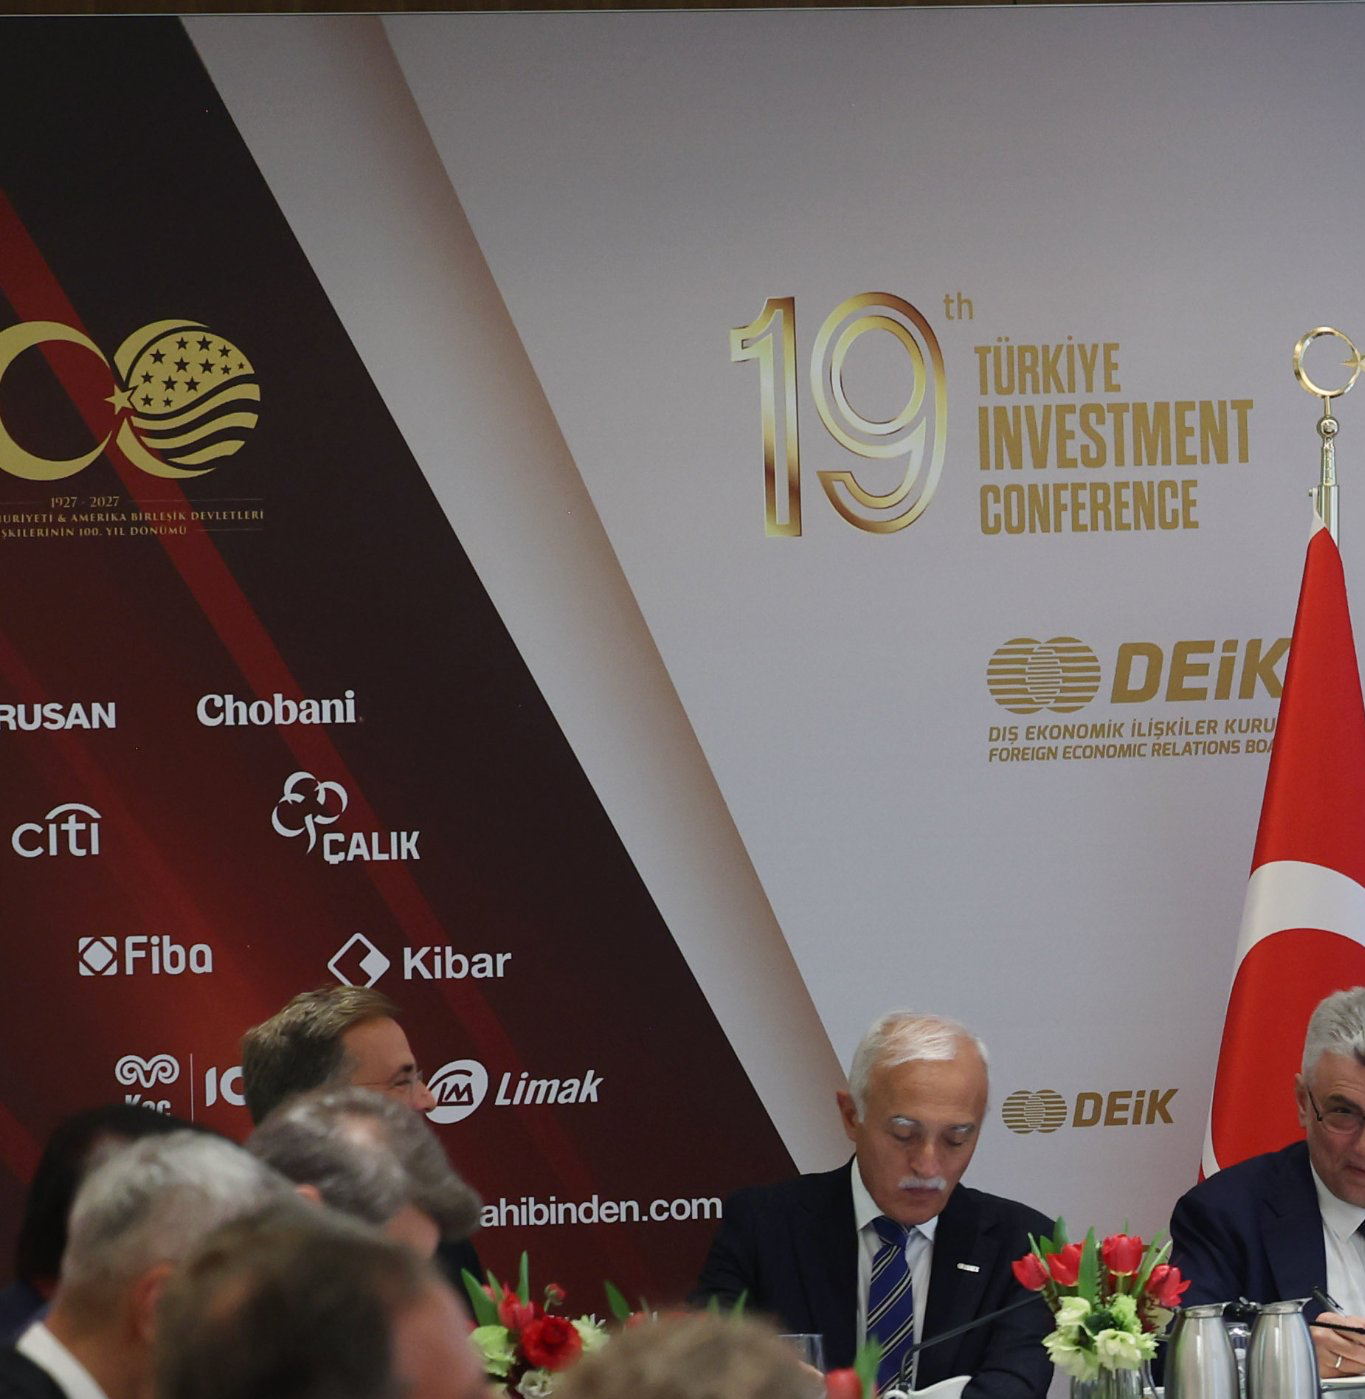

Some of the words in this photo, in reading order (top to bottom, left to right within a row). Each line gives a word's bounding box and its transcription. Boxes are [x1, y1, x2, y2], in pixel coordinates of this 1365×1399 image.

[974, 335, 1121, 396] TÜRKİYE
[977, 398, 1253, 471] INVESTMENT
[0, 513, 53, 524] URİYETİ
[51, 497, 77, 508] 1927
[90, 496, 119, 508] 2027
[979, 479, 1199, 535] CONFERENCE
[1, 527, 75, 539] ŞKİLERİNİN
[0, 702, 117, 731] RUSAN
[196, 690, 356, 727] Chobani
[988, 726, 1019, 745] DIŞ
[1025, 719, 1125, 741] EKONOMİK
[1131, 717, 1219, 741] İLİŞKİLER
[1224, 718, 1276, 735] KURU
[988, 746, 1059, 763] FOREIGN
[1062, 743, 1148, 760] ECONOMIC
[1151, 739, 1241, 757] RELATIONS
[11, 806, 101, 858] citi
[322, 830, 421, 865] ÇALIK
[124, 935, 214, 976] Fiba
[402, 947, 512, 980] Kibar
[494, 1069, 604, 1106] Limak
[480, 1194, 723, 1228] ahibinden.com
